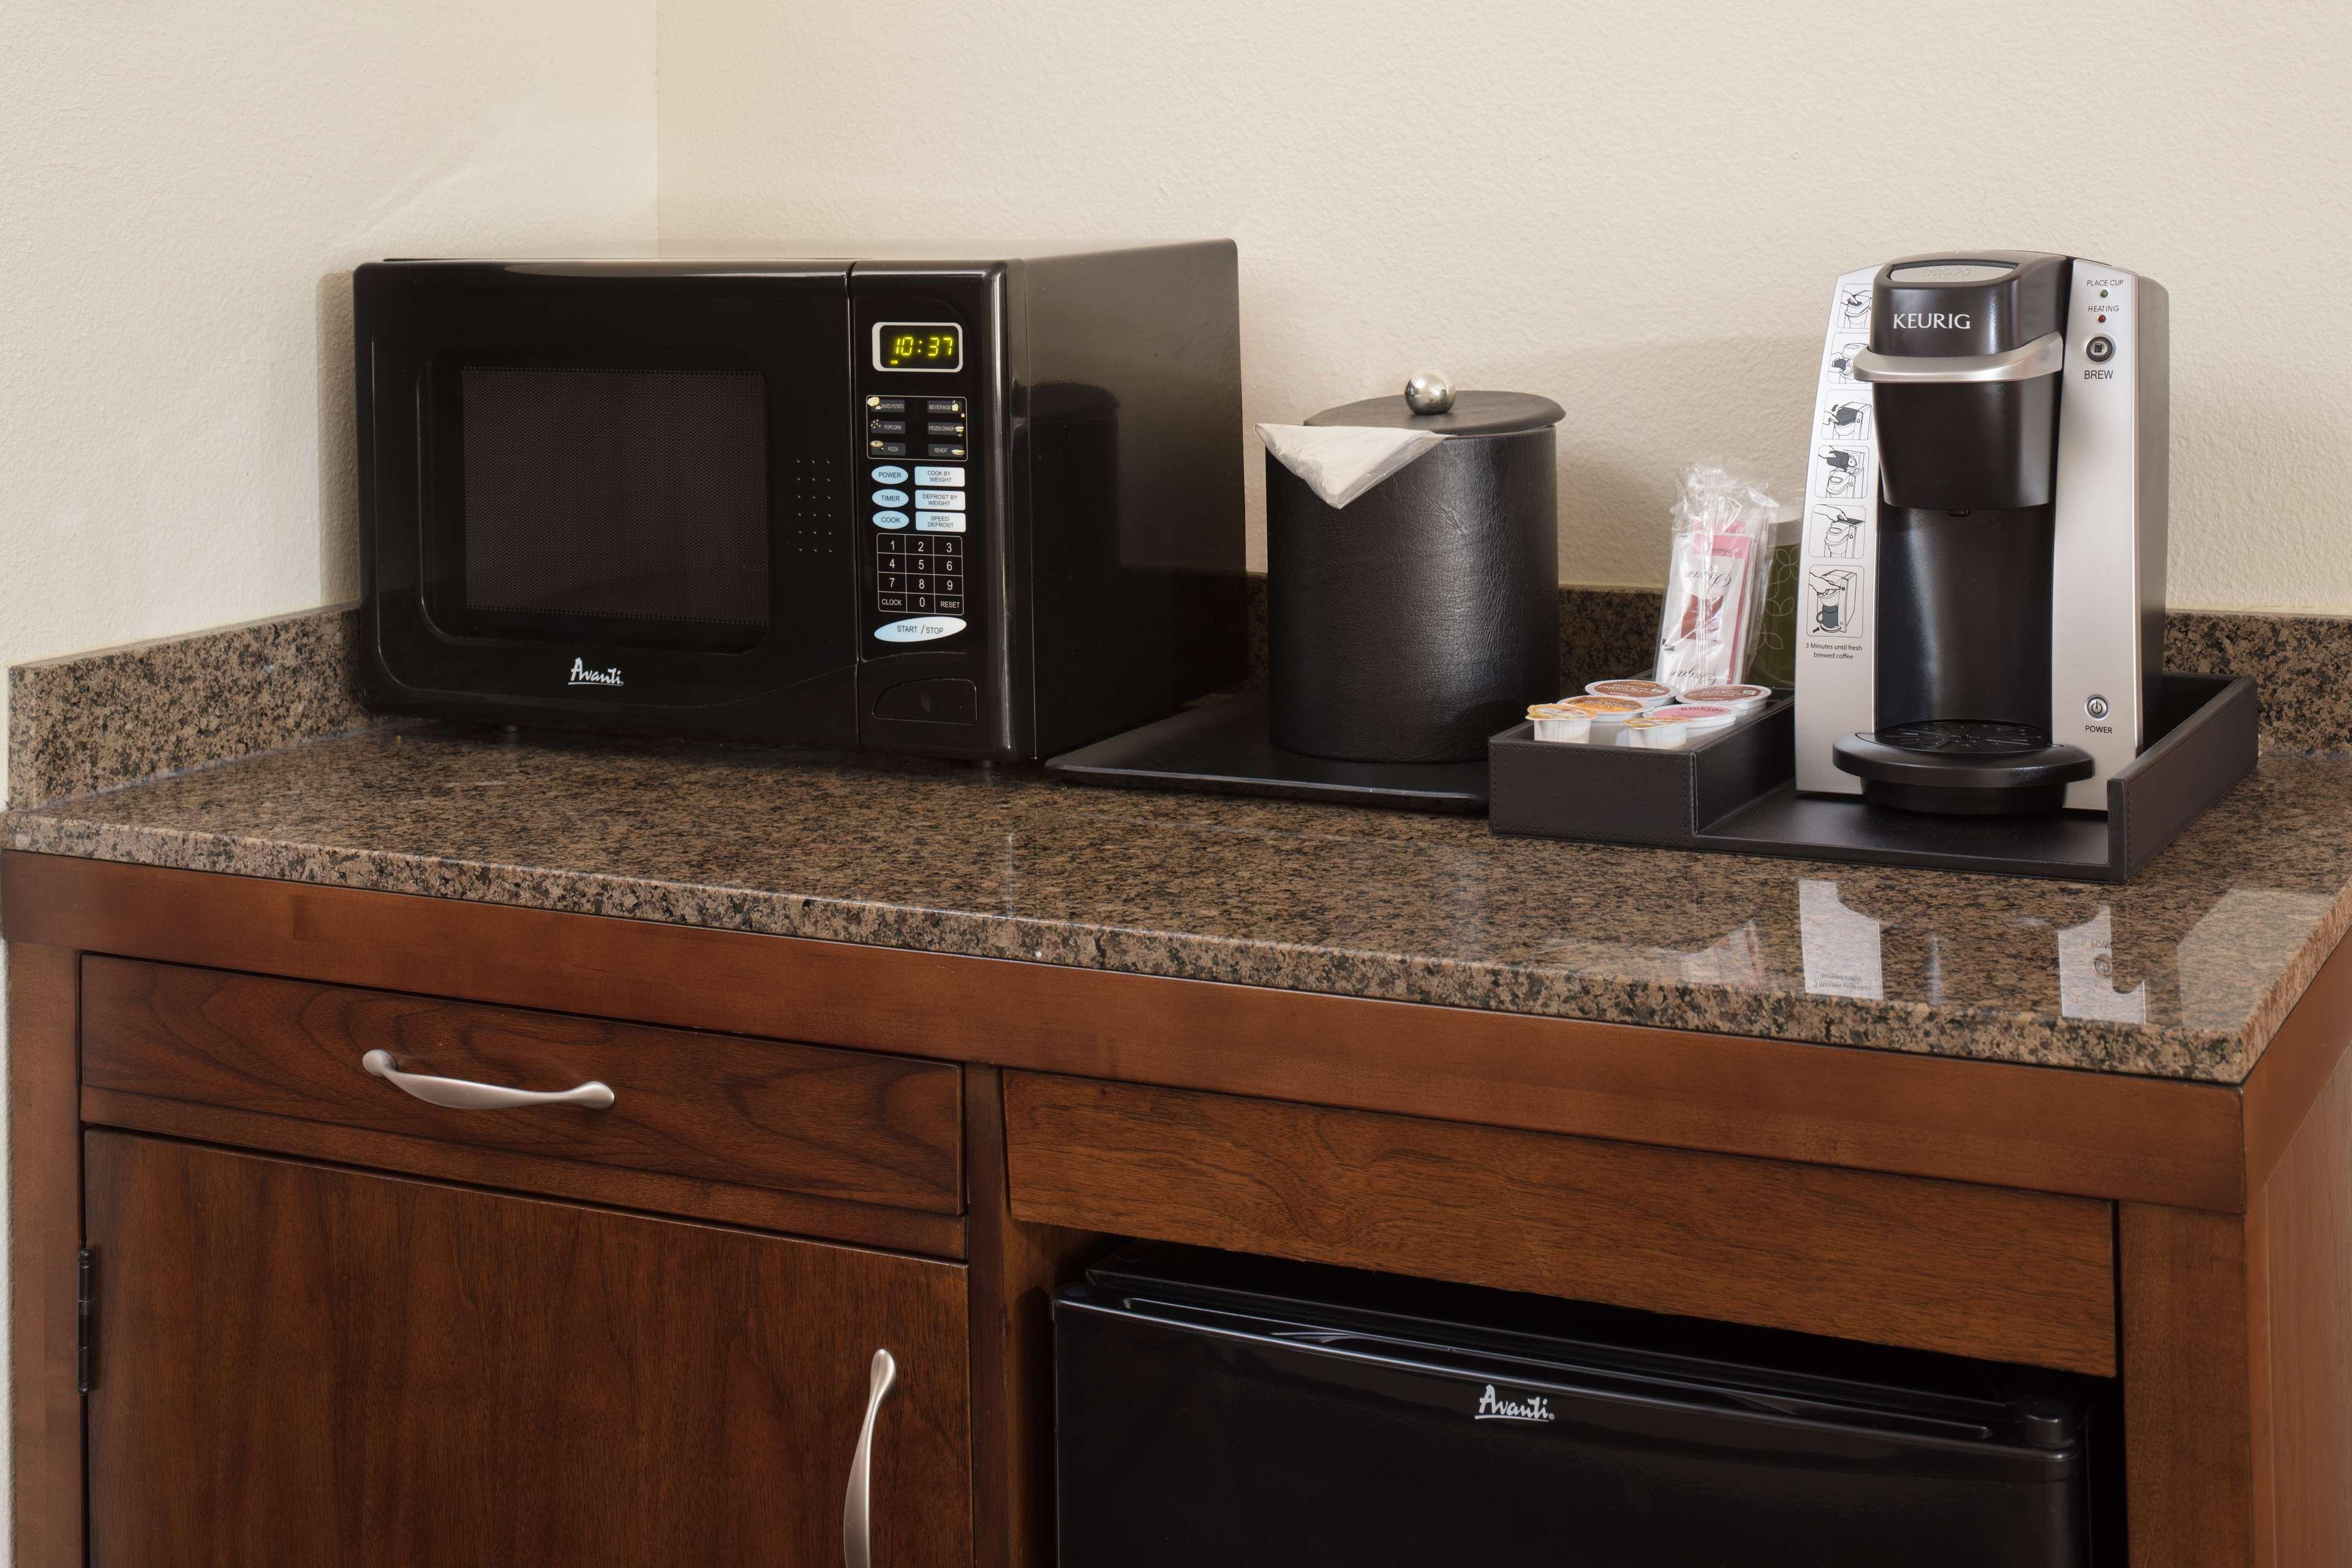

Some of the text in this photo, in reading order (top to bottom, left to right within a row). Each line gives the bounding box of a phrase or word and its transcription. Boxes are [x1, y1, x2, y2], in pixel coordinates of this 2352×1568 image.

[1893, 313, 1970, 329] KEURIG
[895, 336, 953, 356] 10:37
[2084, 370, 2114, 379] BREW
[890, 540, 952, 552] 1 2 3
[889, 559, 952, 571] 4 5 6
[889, 578, 953, 590] 7 8 9
[919, 597, 925, 608] 0
[570, 657, 622, 685] Avanti
[2085, 725, 2113, 734] POWER
[1478, 1384, 1548, 1419] Avanti
